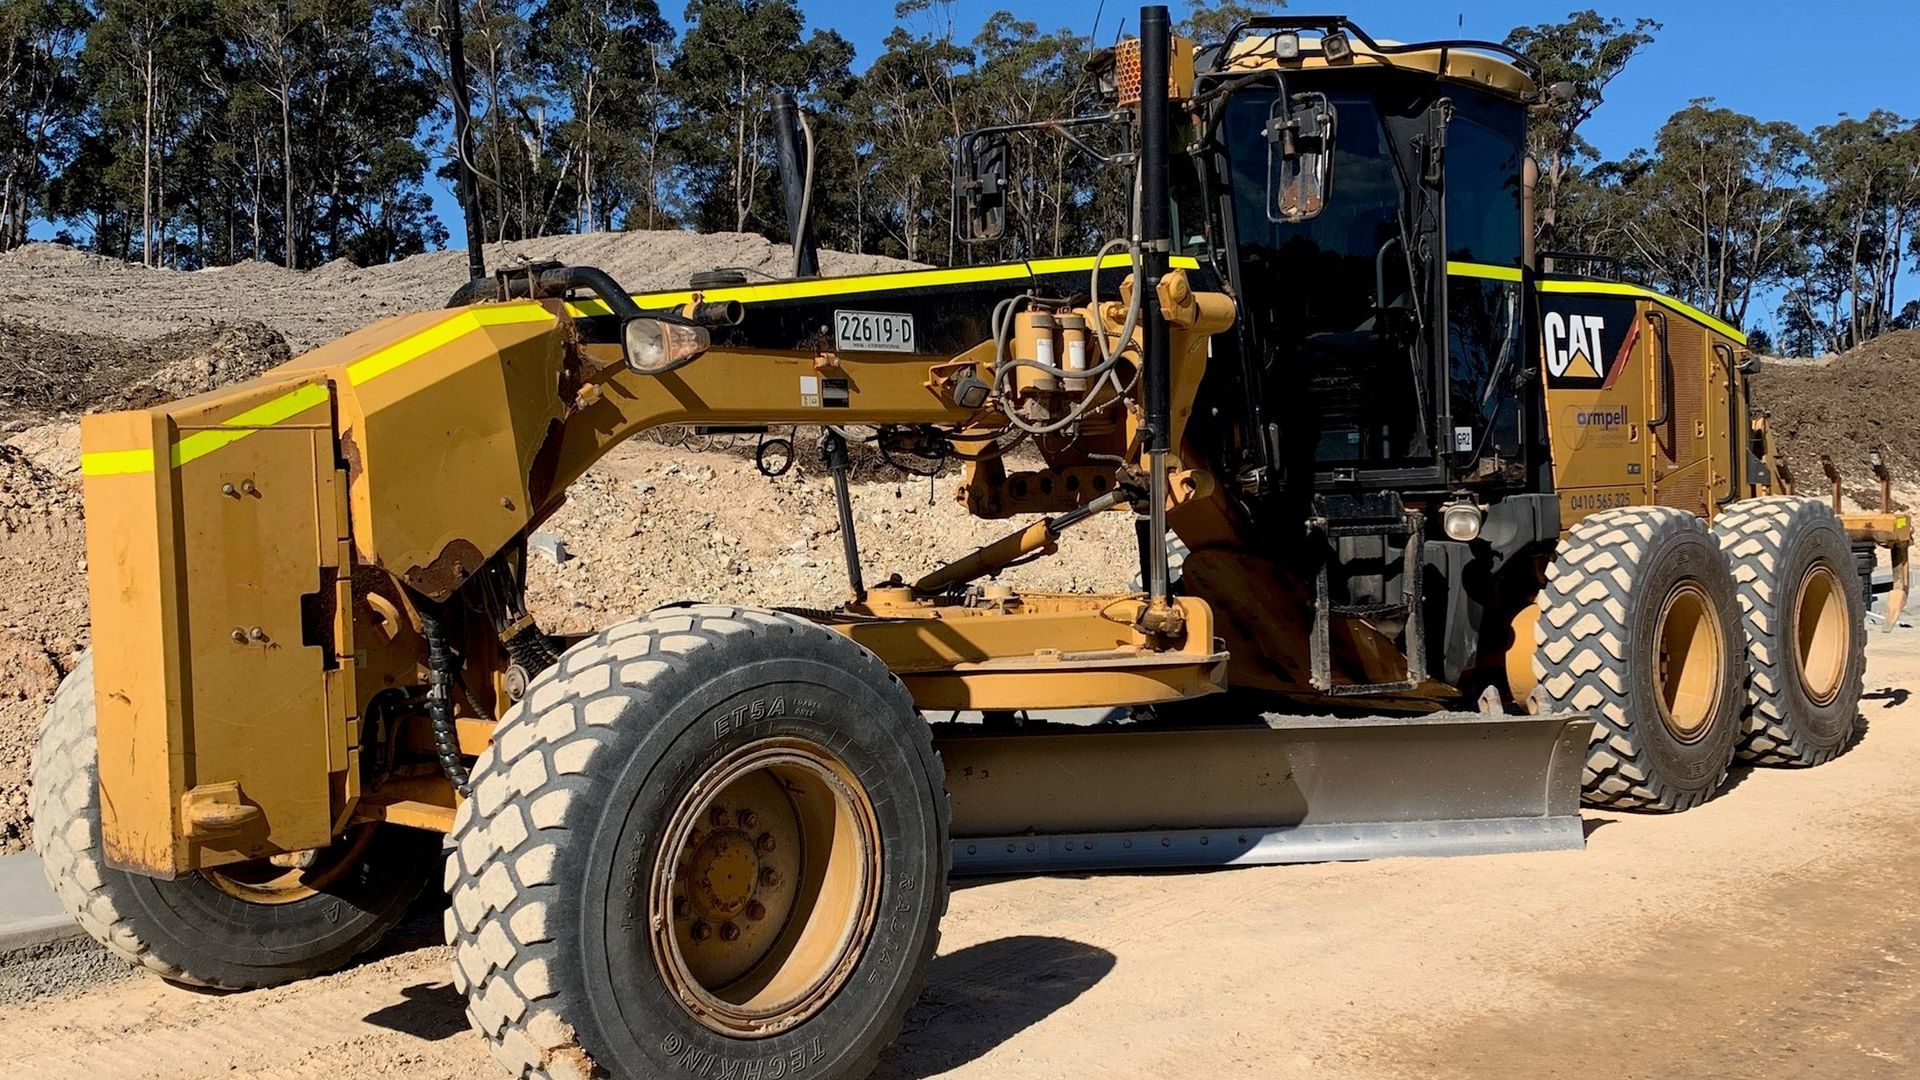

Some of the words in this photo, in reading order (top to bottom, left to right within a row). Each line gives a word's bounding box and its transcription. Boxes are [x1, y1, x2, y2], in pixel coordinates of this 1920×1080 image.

[1544, 311, 1604, 378] CAT
[1577, 405, 1628, 430] armpell
[1571, 494, 1595, 510] 0410
[660, 1031, 827, 1080] TECHKING
